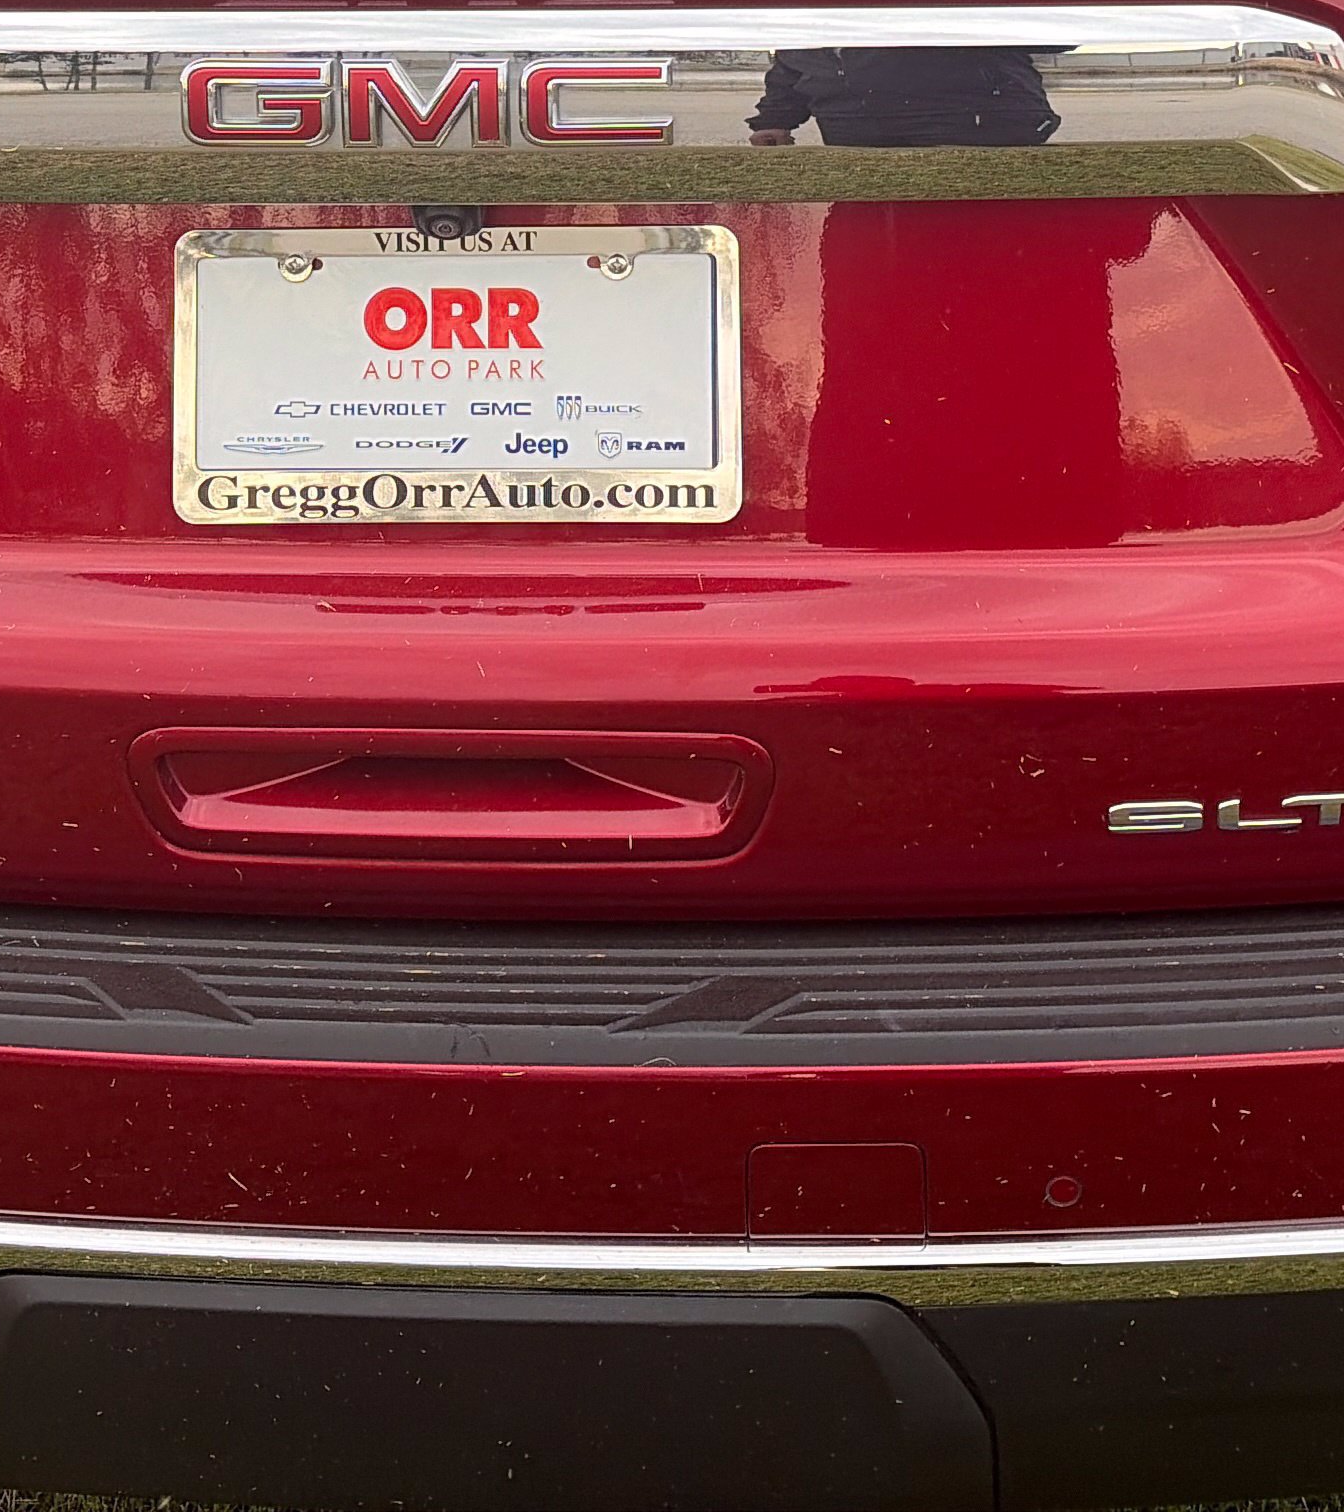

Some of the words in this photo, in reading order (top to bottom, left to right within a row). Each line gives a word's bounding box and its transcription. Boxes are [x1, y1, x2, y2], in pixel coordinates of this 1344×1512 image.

[180, 57, 674, 148] GMC
[460, 231, 493, 252] US
[500, 231, 538, 252] AT
[363, 287, 543, 350] ORR
[362, 359, 452, 380] AUTO
[467, 359, 546, 380] PARK
[329, 402, 448, 417] CHEVROLET
[470, 402, 532, 417] GMC
[584, 403, 644, 415] BUICK
[236, 435, 311, 444] CHRYSLER
[355, 439, 452, 450] DODGE
[504, 432, 569, 458] Jeep
[626, 439, 687, 451] RAM
[197, 473, 718, 519] GreggOrrAuto.com
